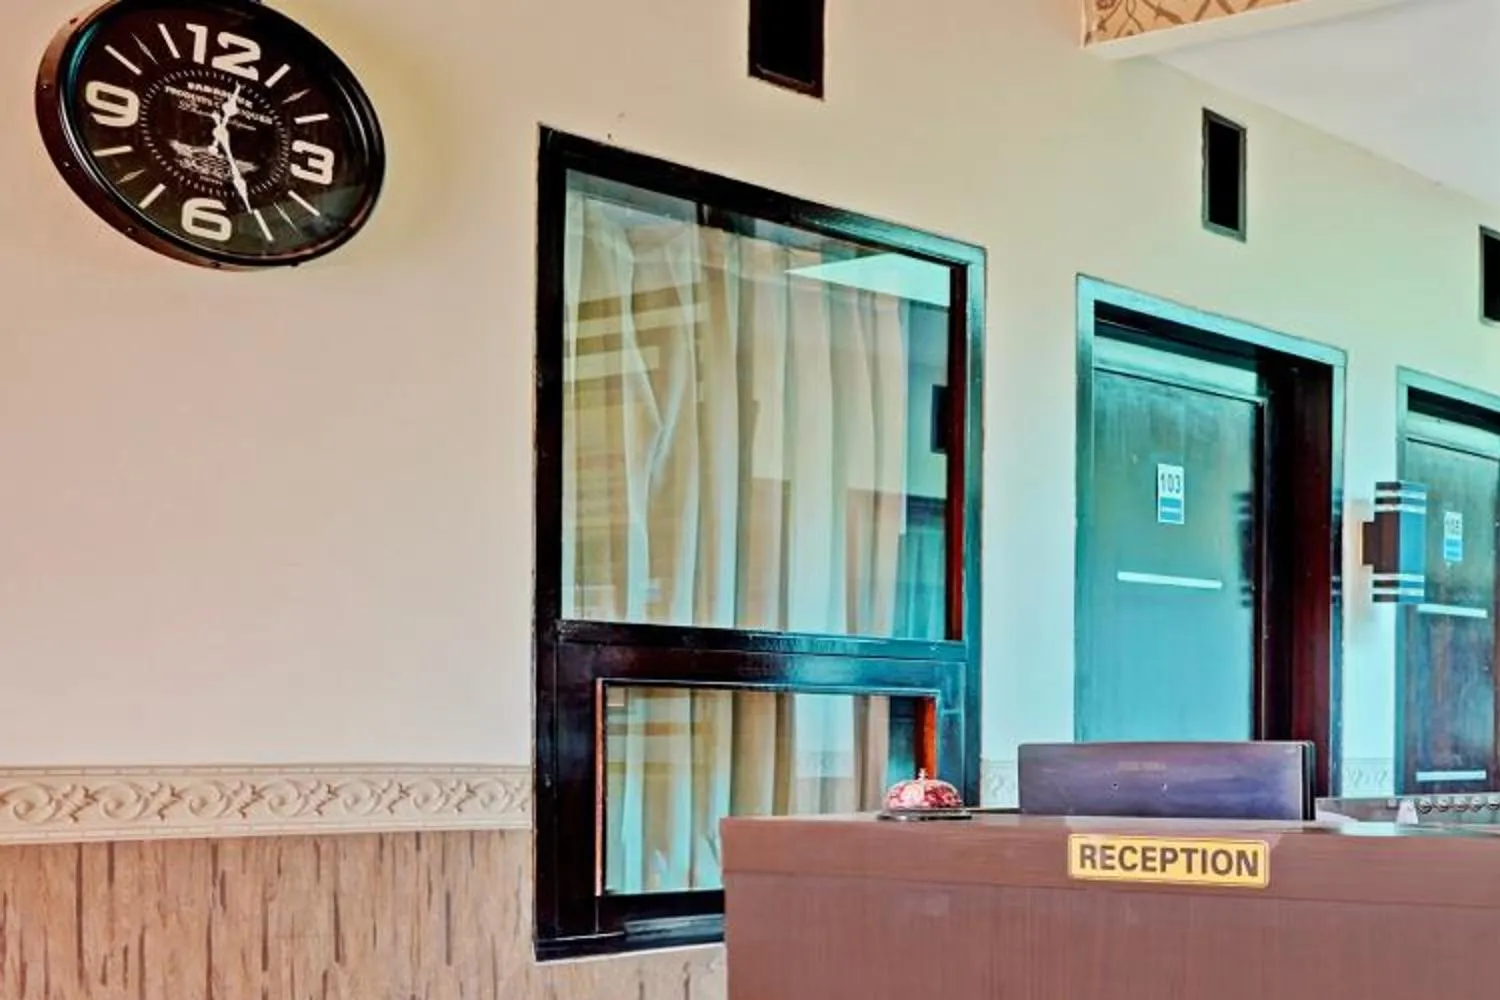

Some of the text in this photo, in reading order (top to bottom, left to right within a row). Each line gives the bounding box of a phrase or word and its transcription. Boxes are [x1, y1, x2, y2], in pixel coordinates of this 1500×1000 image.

[186, 23, 261, 82] 12
[85, 80, 140, 128] 9
[290, 140, 335, 185] 3
[181, 197, 233, 242] 6
[1161, 473, 1181, 494] 103
[1078, 843, 1259, 877] RECEPTION
